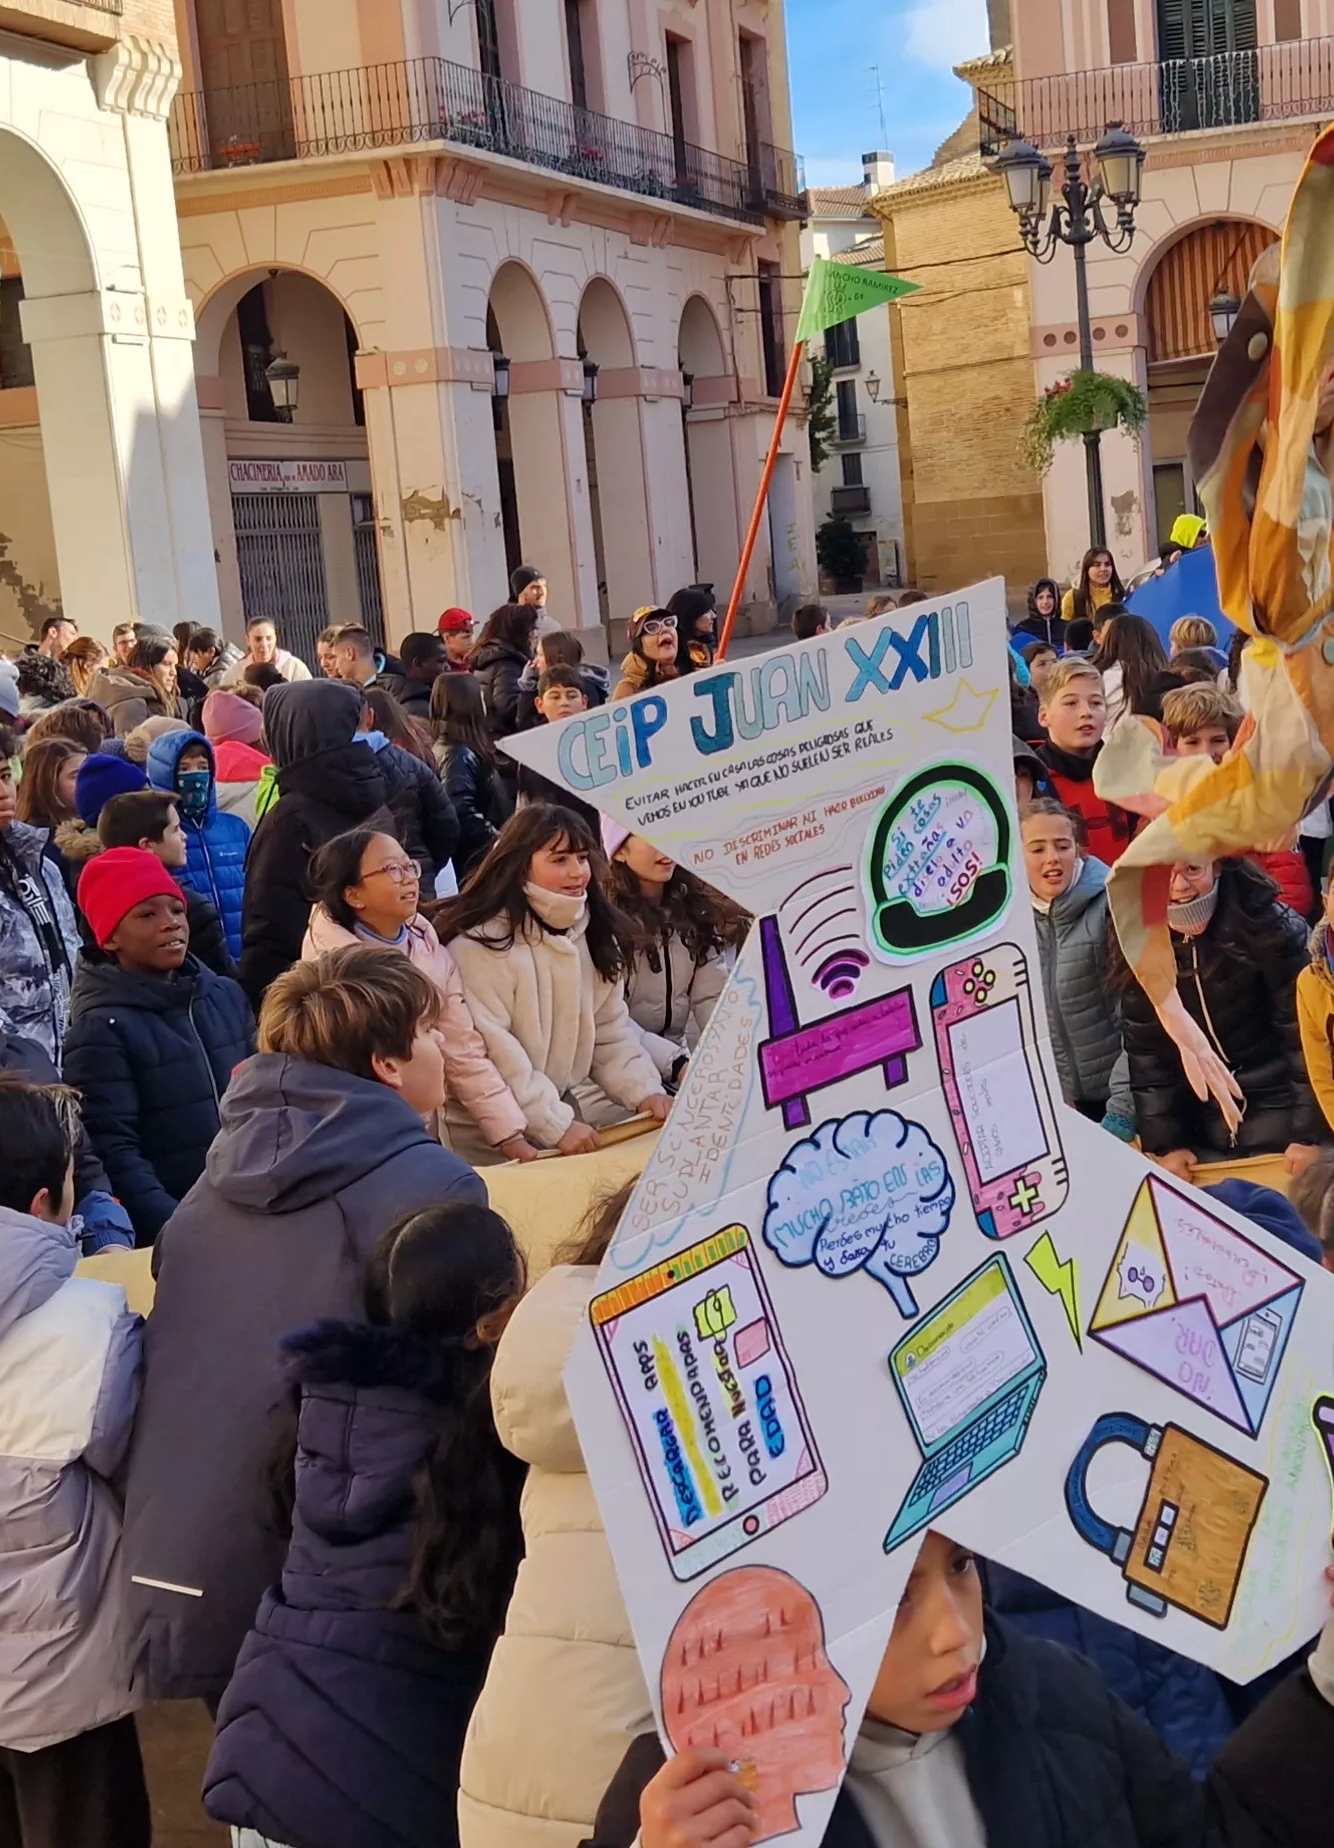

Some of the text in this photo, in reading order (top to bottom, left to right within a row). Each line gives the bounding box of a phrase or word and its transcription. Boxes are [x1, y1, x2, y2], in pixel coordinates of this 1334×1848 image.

[230, 463, 281, 481] CHACINERIA
[690, 648, 830, 755] JUAN
[845, 601, 973, 702] XXIII
[854, 719, 873, 735] QUE
[773, 764, 789, 781] NO
[831, 741, 851, 759] SER
[693, 849, 714, 865] NO
[723, 816, 798, 857] DISCRIMINAR
[802, 810, 817, 826] NI
[735, 850, 749, 866] EN
[753, 839, 781, 860] REDES
[631, 1176, 668, 1231] SER
[773, 1198, 834, 1248] MUCHO
[916, 1159, 941, 1187] LAS
[888, 1237, 936, 1269] CEREBRO
[755, 1373, 785, 1458] EDAD
[655, 1408, 701, 1527] DESCARGAR
[738, 1420, 767, 1487] PARA
